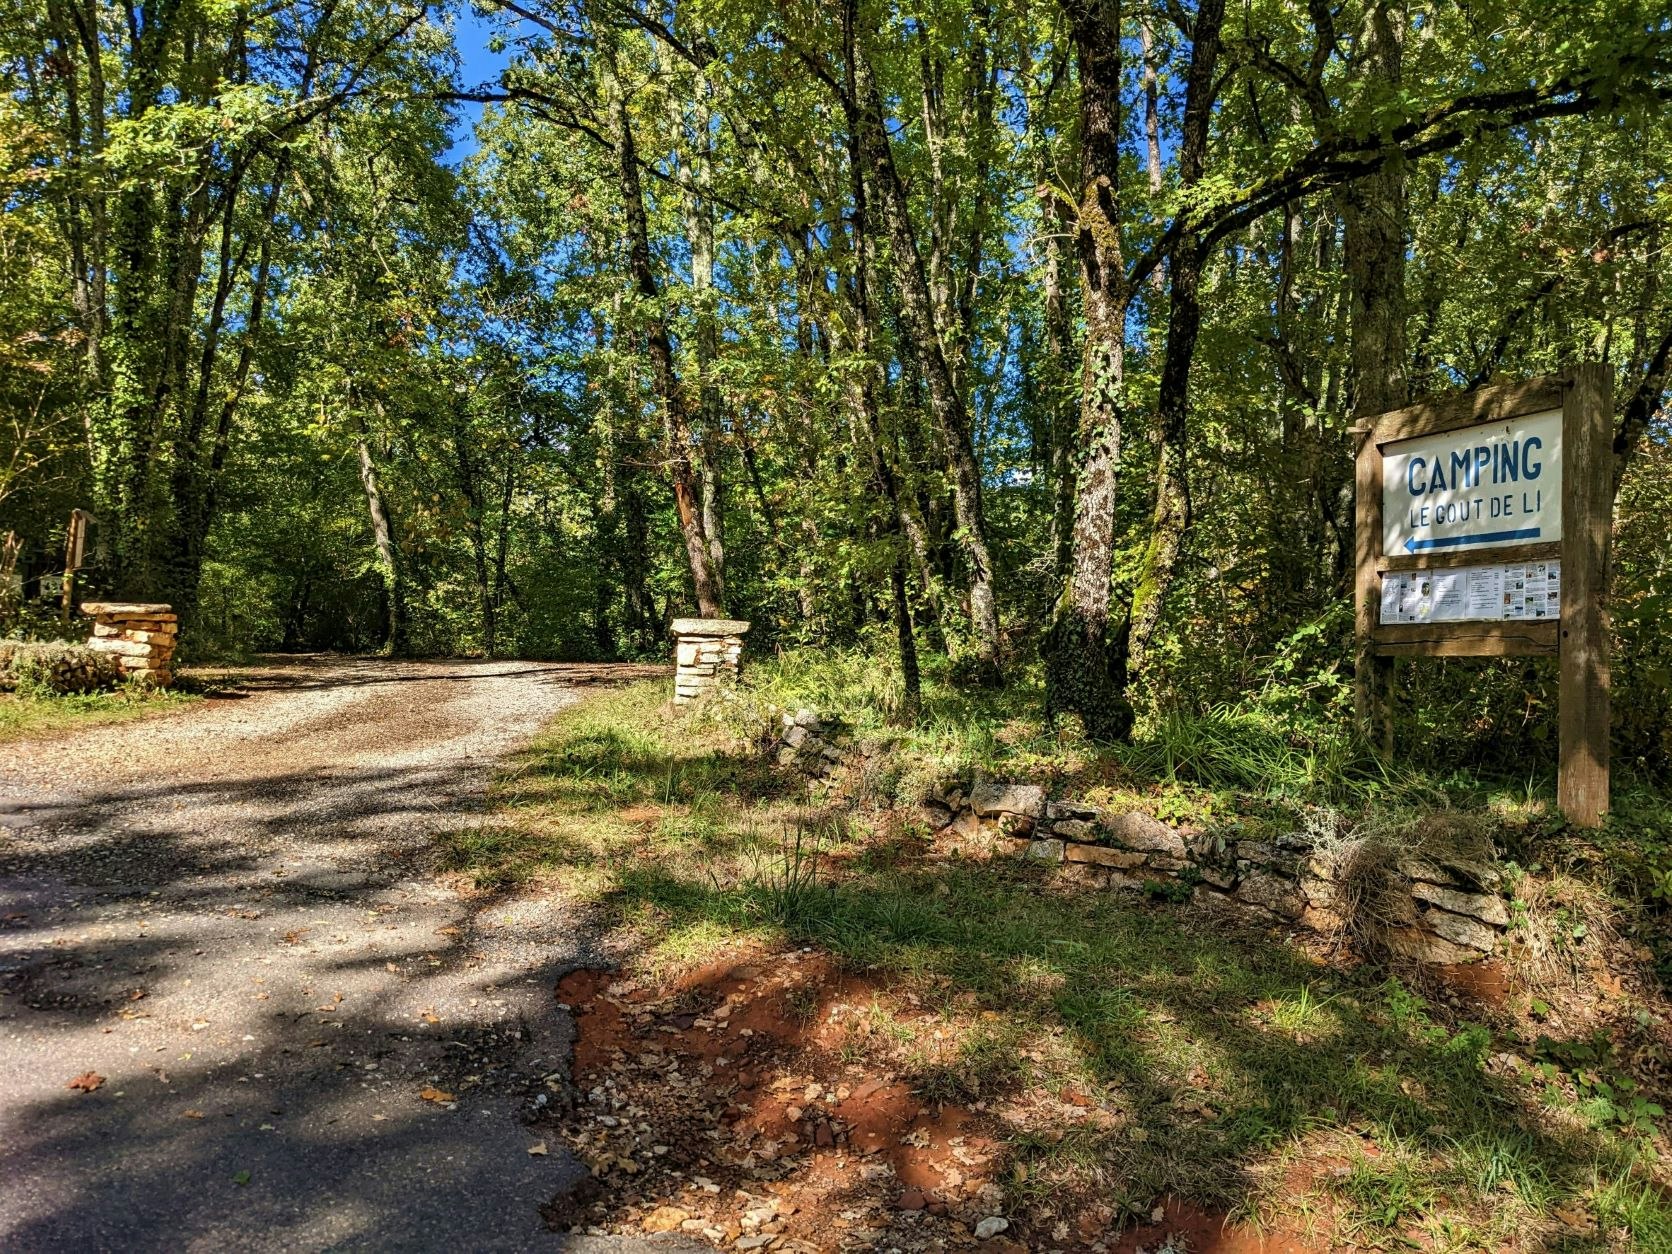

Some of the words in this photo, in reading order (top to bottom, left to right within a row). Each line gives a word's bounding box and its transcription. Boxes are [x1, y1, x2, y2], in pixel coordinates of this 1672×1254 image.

[1409, 437, 1542, 496] CAMPING
[1410, 507, 1430, 528] LE
[1436, 499, 1483, 524] GOUT
[1490, 495, 1513, 518] DE
[1523, 490, 1541, 513] LI
